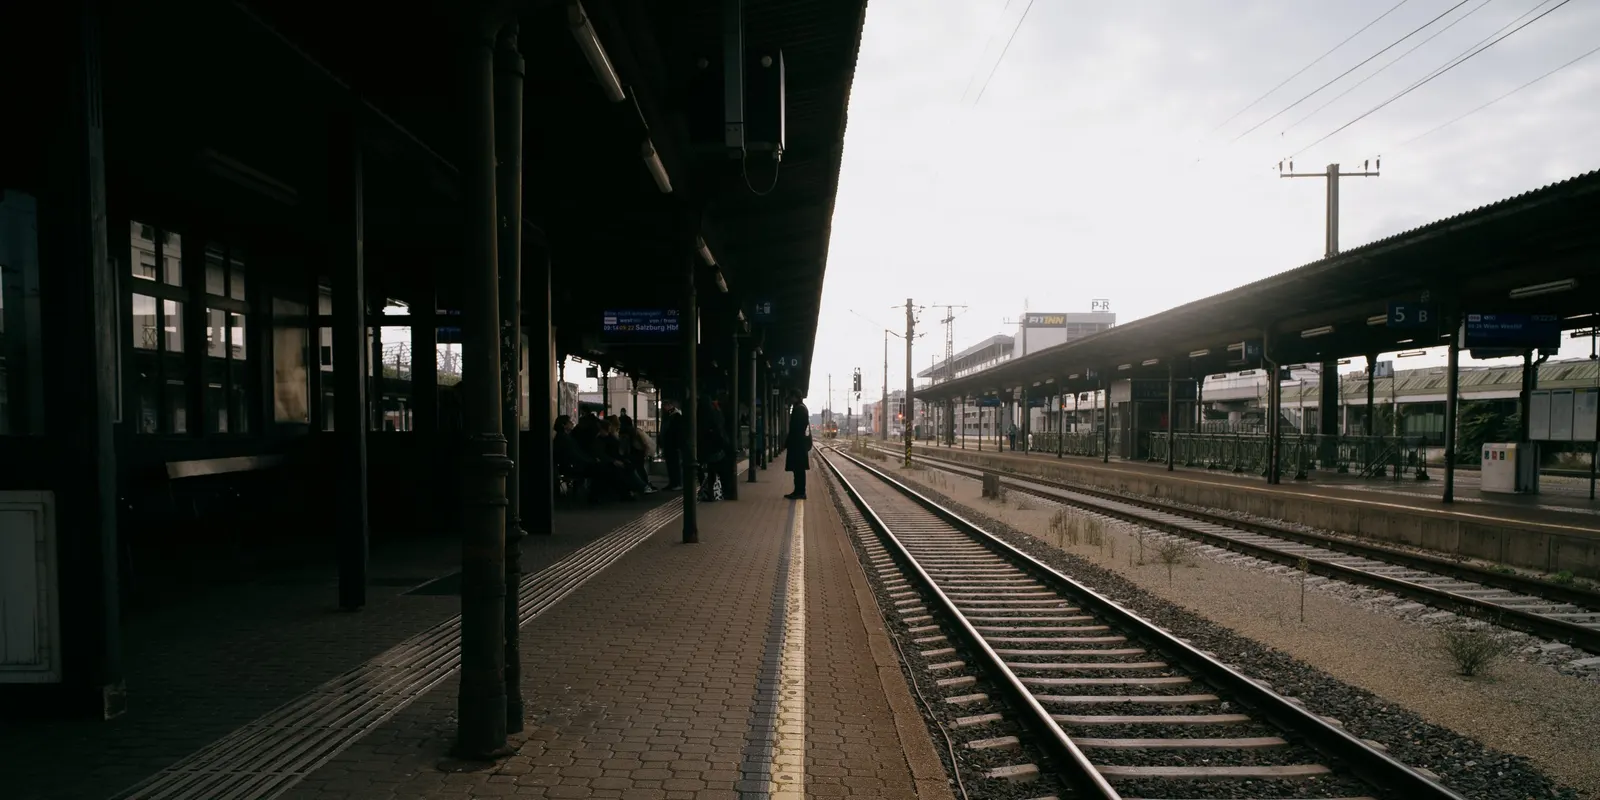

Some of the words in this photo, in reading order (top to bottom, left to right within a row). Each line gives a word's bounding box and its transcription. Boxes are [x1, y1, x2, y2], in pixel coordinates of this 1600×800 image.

[1395, 306, 1405, 323] 5
[1418, 309, 1428, 323] B
[635, 324, 665, 332] Salzburg
[778, 357, 785, 366] 4
